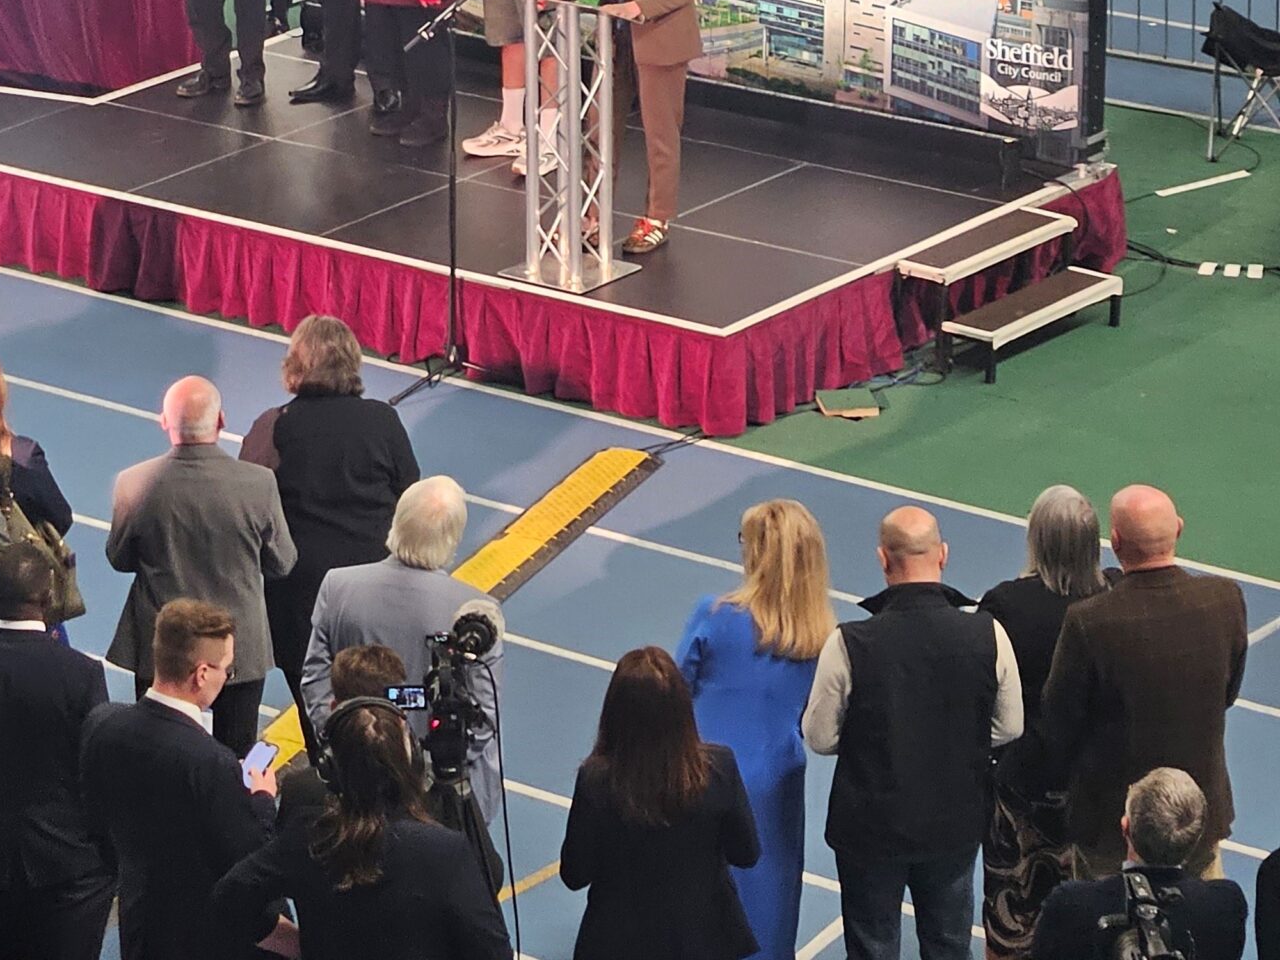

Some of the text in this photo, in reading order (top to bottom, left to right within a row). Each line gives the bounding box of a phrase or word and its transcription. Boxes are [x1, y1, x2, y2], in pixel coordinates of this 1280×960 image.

[985, 39, 1073, 70] Sheffield
[997, 63, 1061, 83] City Council
